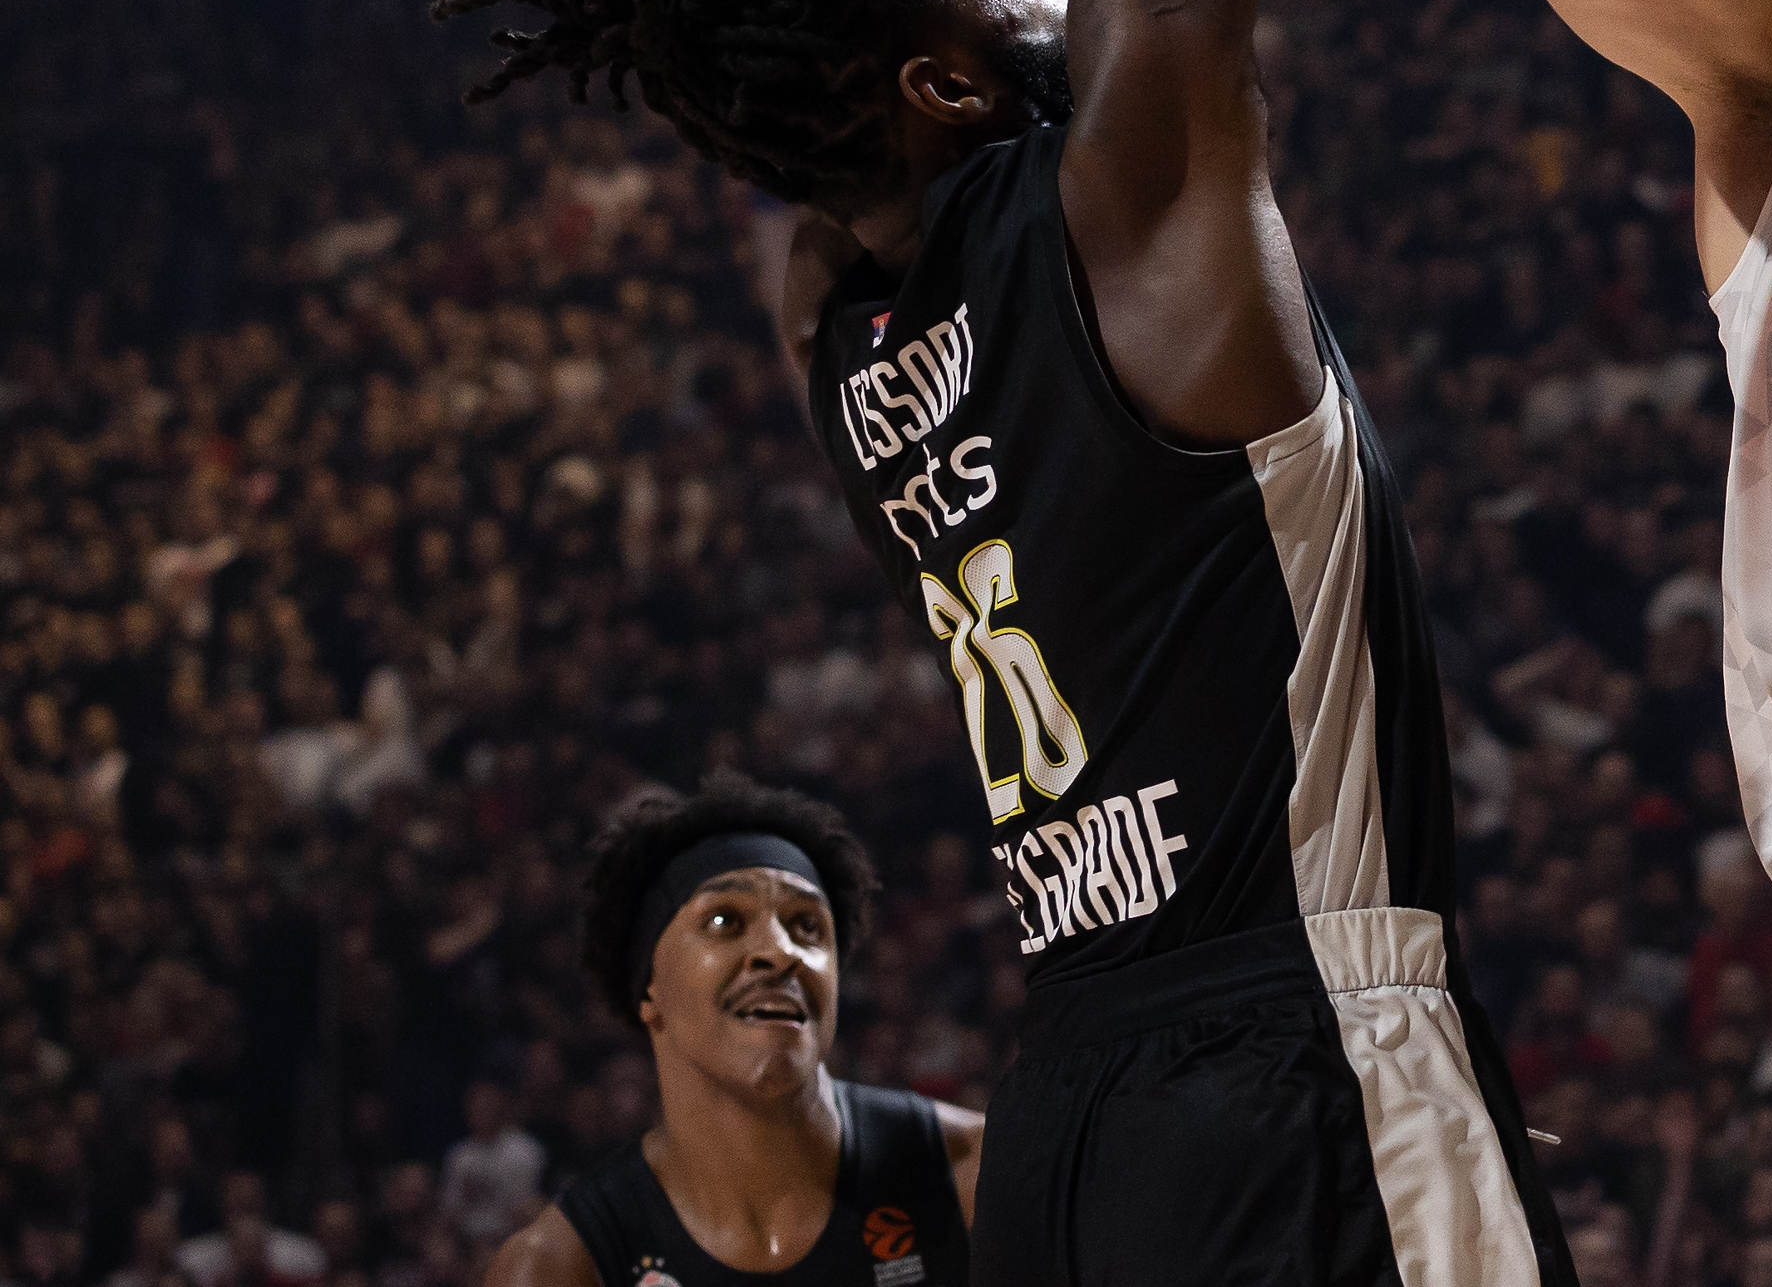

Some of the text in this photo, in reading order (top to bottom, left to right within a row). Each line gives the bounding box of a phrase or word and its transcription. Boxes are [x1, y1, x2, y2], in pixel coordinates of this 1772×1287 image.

[839, 302, 974, 472] LESSORT
[880, 435, 998, 562] mts
[919, 538, 1089, 826] 26
